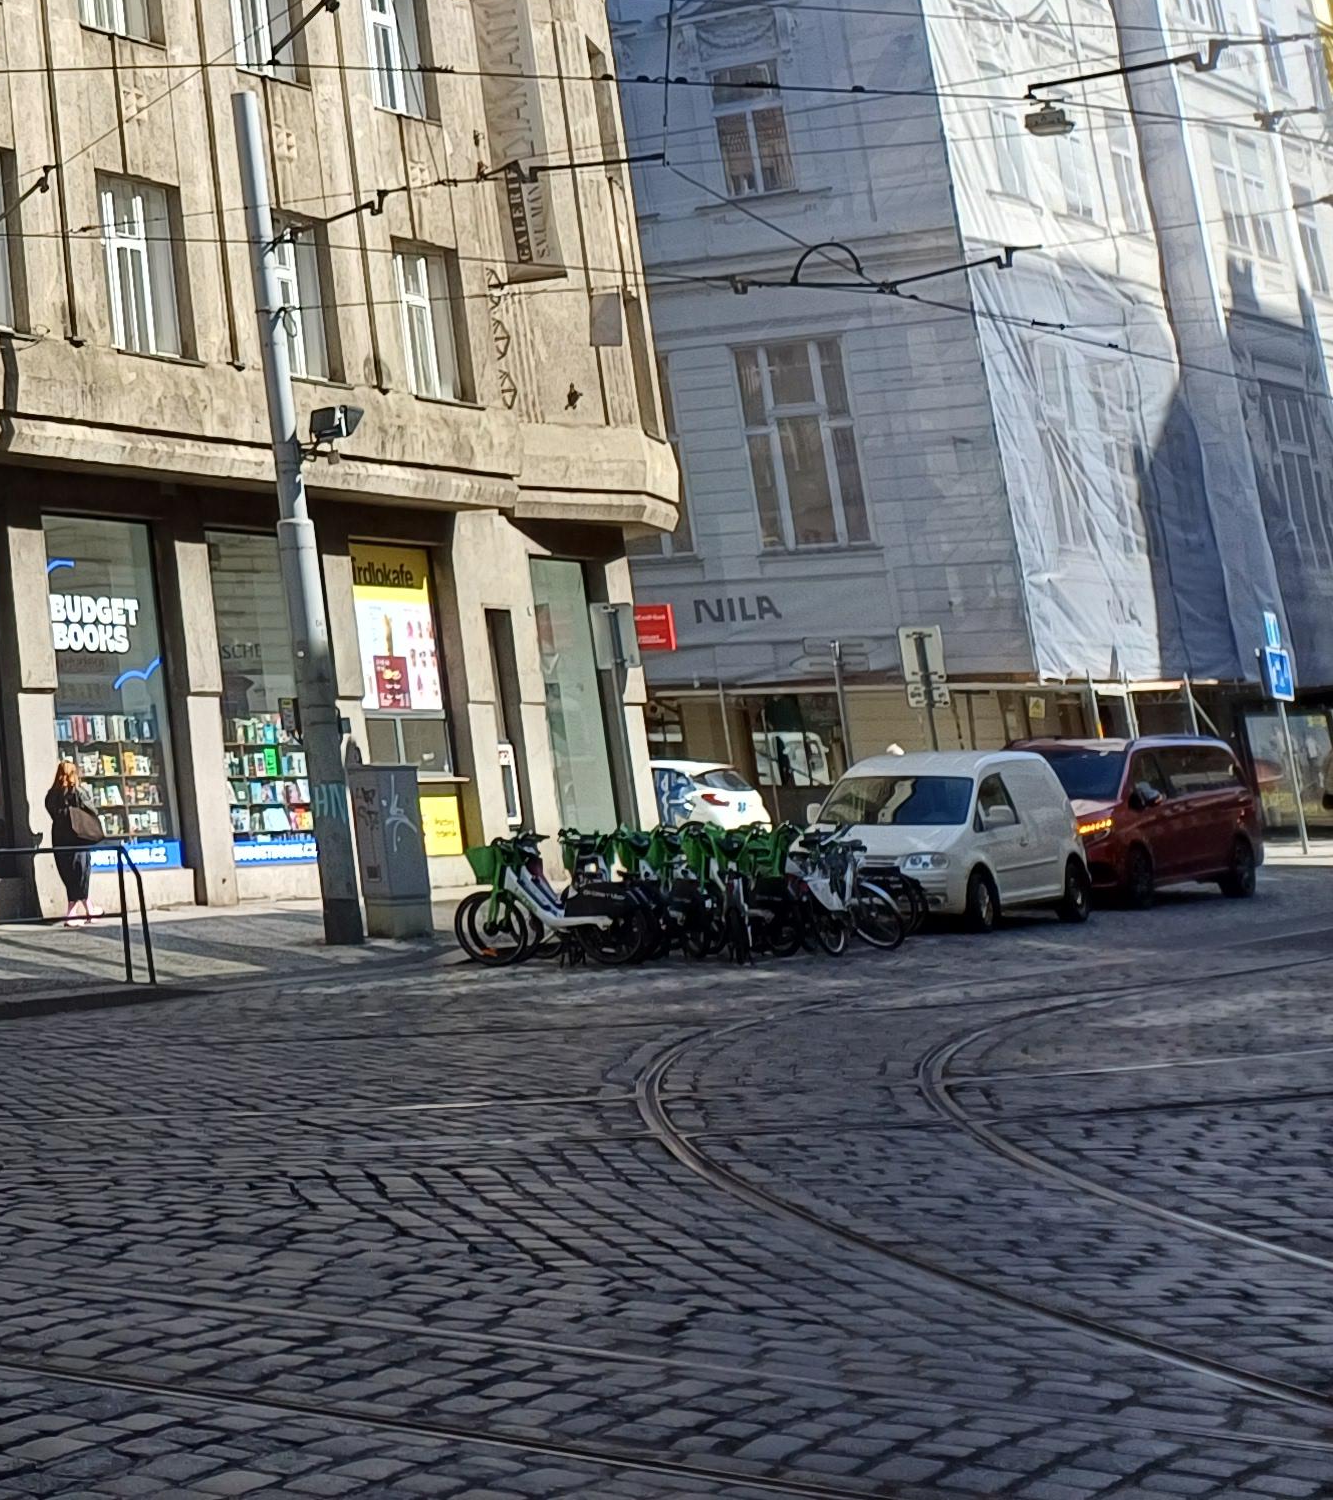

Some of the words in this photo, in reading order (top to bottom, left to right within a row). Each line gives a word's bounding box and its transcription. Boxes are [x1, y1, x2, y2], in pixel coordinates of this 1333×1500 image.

[49, 594, 139, 627] BUDGET
[693, 595, 782, 624] NILA
[51, 622, 130, 653] BOOKS
